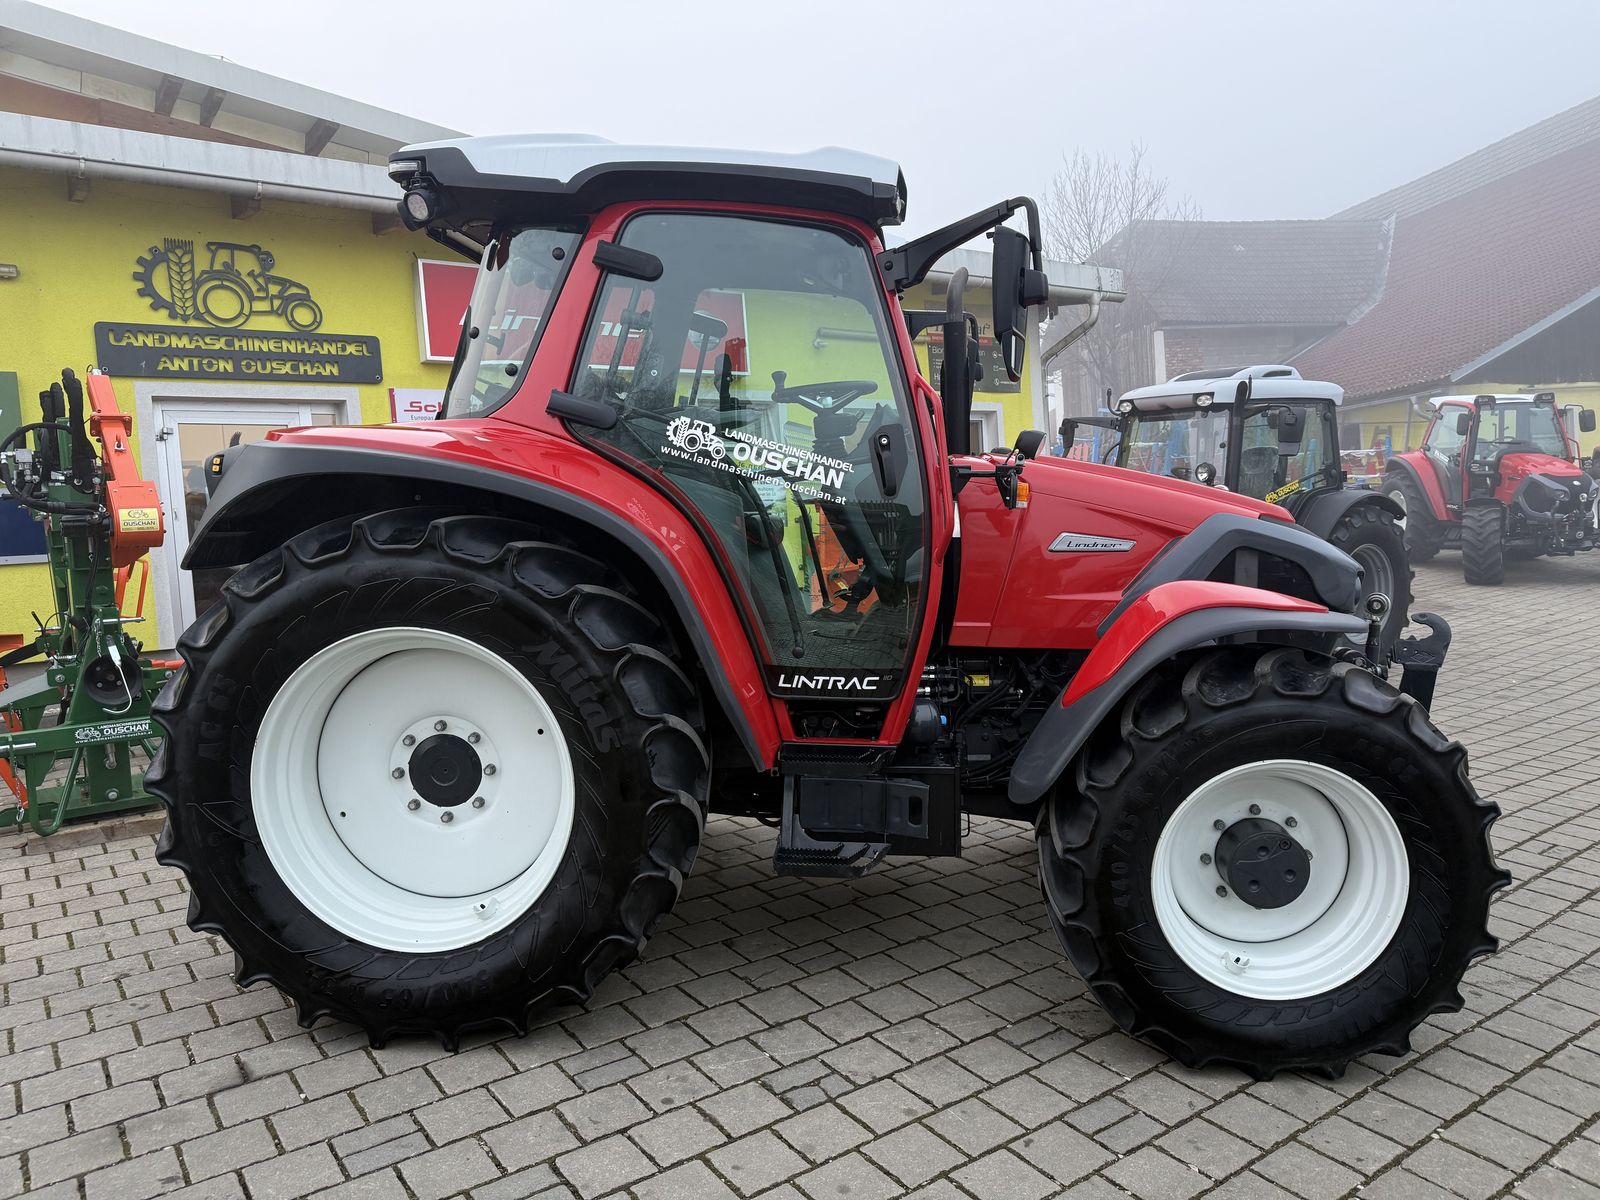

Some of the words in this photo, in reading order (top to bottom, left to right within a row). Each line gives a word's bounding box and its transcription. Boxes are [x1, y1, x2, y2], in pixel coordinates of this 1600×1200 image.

[108, 329, 373, 357] LANDMASCHINENHANDEL
[156, 354, 234, 373] ANTON
[241, 358, 340, 377] OUSCHAN
[725, 427, 855, 473] LANDMASCHINENHANDEL
[660, 444, 847, 506] www.landmaschinen-ouschan.at
[733, 442, 845, 489] OUSCHAN
[1066, 540, 1122, 549] Lindner
[778, 673, 880, 690] LINTRAC
[103, 723, 149, 735] OUSCHAN
